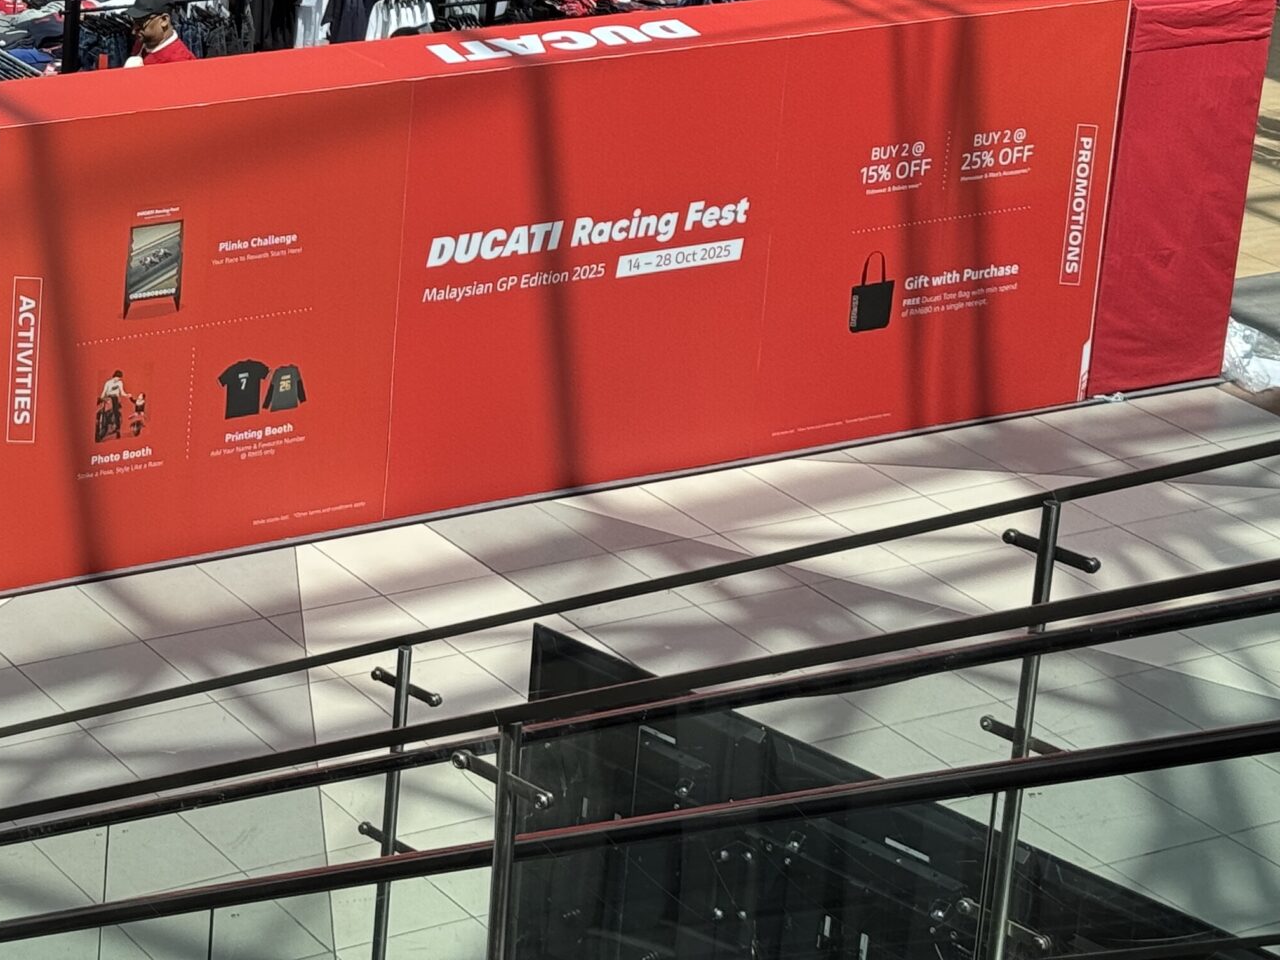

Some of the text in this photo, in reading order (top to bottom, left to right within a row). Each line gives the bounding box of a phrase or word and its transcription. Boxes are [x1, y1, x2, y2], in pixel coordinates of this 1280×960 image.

[425, 19, 702, 64] DUCATI
[973, 128, 1027, 147] BUY 2 @
[871, 141, 925, 161] BUY 2 @
[960, 144, 1035, 171] 25% OFF
[860, 158, 932, 185] 15% OFF
[1065, 136, 1093, 274] PROMOTIONS
[218, 233, 298, 252] Plinko Challenge
[426, 197, 750, 268] DUCATI Racing Fest
[627, 258, 641, 272] 14
[656, 253, 671, 268] 28
[675, 249, 698, 265] Oct
[700, 244, 731, 261] 2025
[422, 263, 606, 303] Malaysian GP Edition 2025
[904, 264, 1019, 290] Gift with Purchase
[902, 297, 920, 307] FREE
[958, 290, 970, 299] Bag
[13, 294, 37, 425] ACTIVITIES
[240, 378, 247, 390] 7
[279, 380, 291, 392] 26
[225, 423, 293, 443] Printing Booth
[91, 446, 152, 466] Photo Booth
